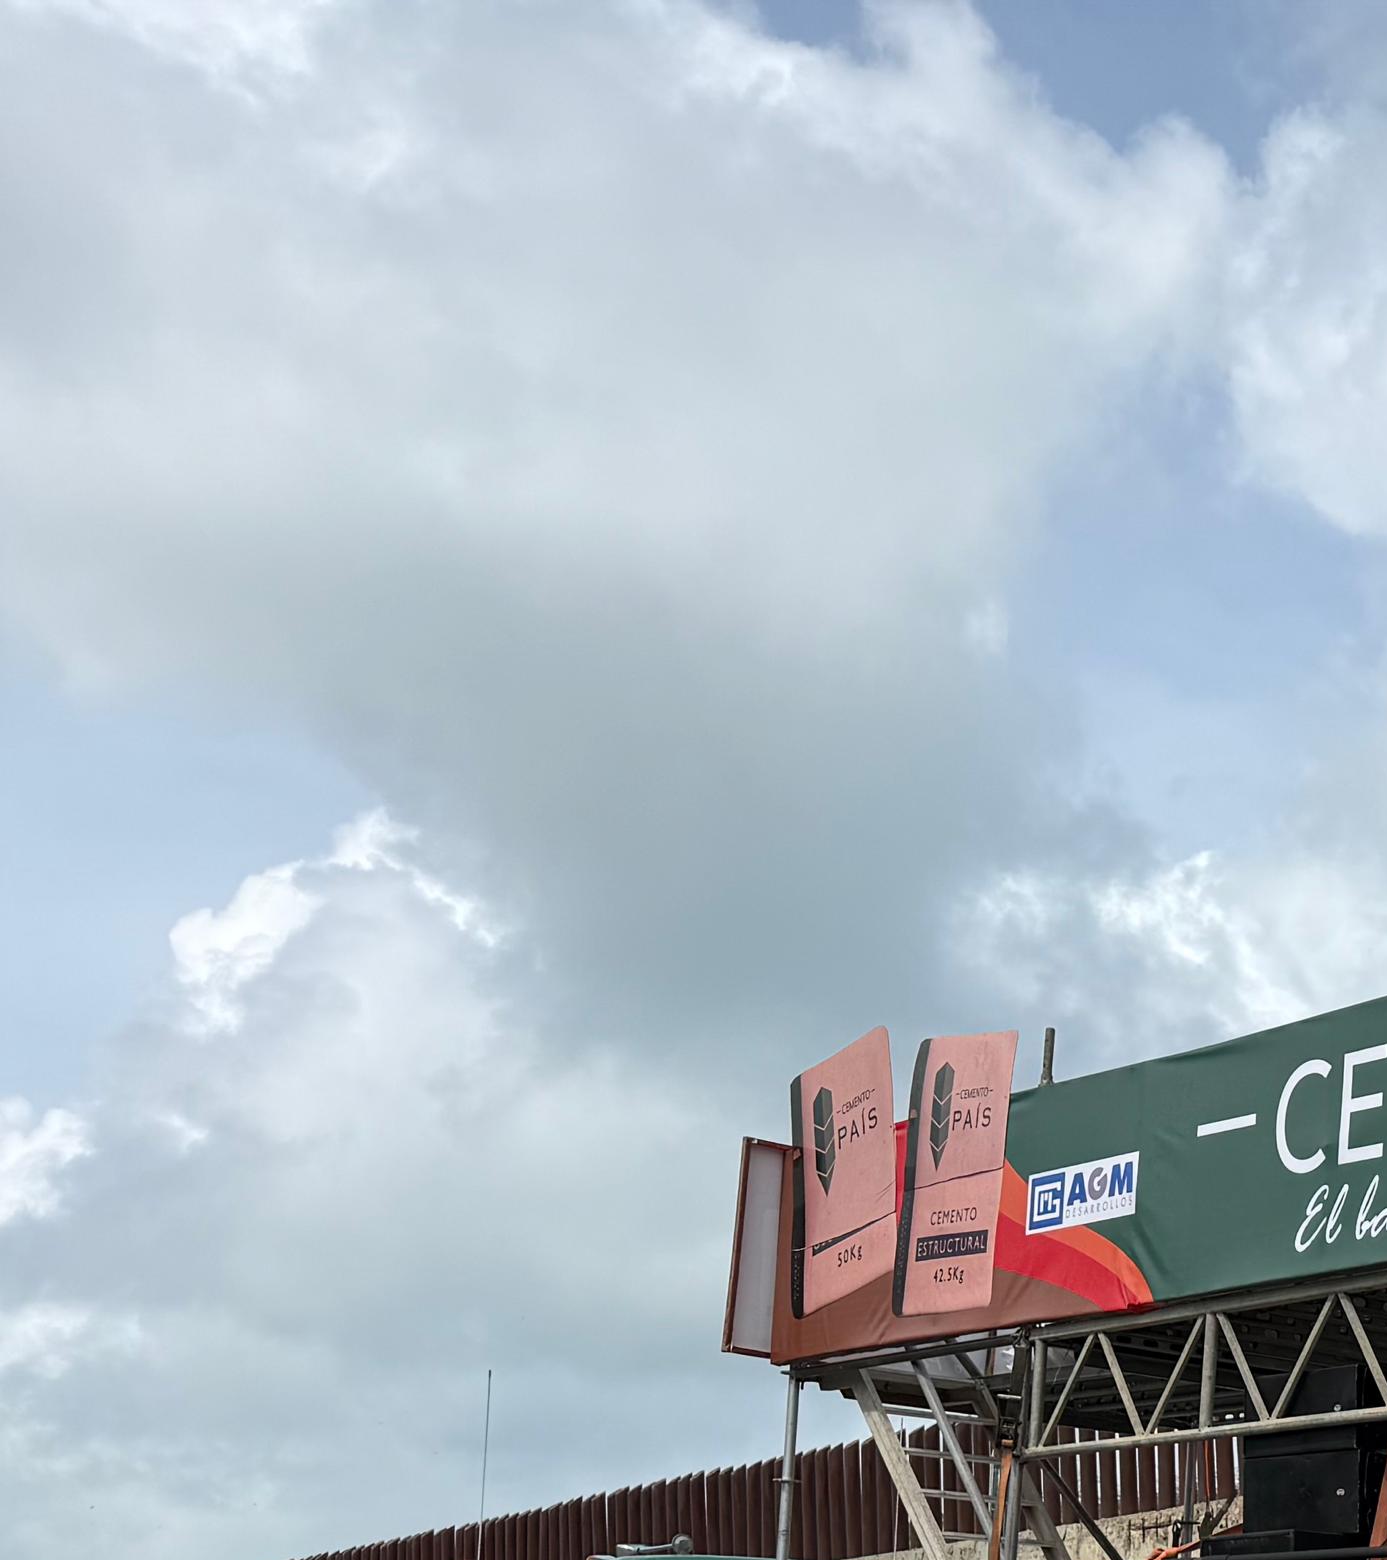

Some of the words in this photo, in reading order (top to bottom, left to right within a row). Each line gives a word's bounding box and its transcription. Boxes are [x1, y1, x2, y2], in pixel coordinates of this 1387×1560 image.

[841, 1091, 871, 1115] CEMENTO
[960, 1087, 990, 1100] CEMENTO
[837, 1106, 879, 1150] PAÍS
[952, 1102, 992, 1131] PAÍS
[1067, 1161, 1134, 1207] AGM
[930, 1206, 978, 1226] CEMENTO
[1065, 1196, 1133, 1219] DESARROLLOS
[1294, 1183, 1345, 1253] El
[837, 1243, 863, 1268] 50Kg
[917, 1237, 985, 1257] ESTRUCTURAL
[933, 1266, 965, 1285] 42.5Kg
